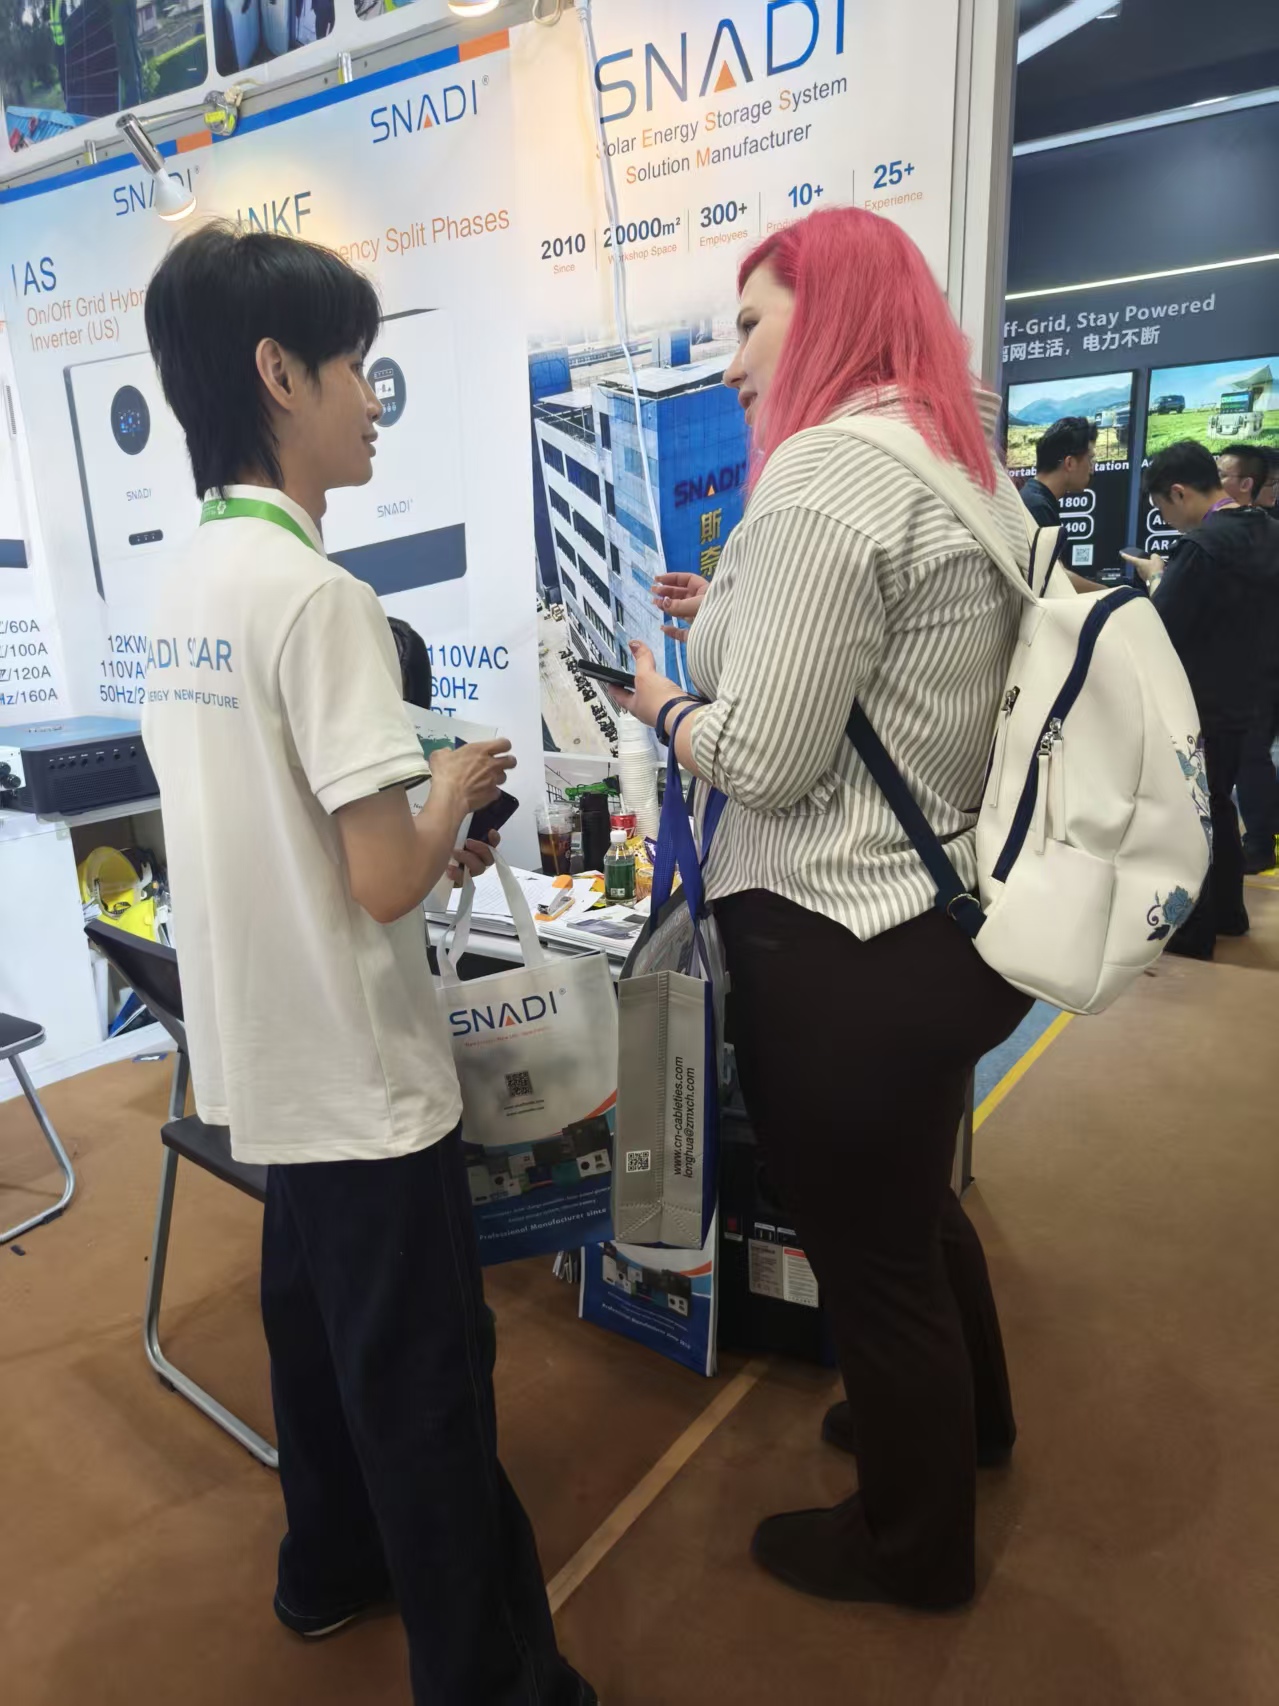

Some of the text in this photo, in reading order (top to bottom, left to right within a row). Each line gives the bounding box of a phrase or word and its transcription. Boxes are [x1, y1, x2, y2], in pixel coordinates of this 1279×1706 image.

[595, 0, 845, 124] SNADI
[371, 79, 477, 143] SNADI
[642, 120, 699, 149] Energy
[704, 99, 772, 132] Storage
[779, 77, 848, 112] System
[626, 124, 812, 184] Solution Manufacturer
[873, 160, 915, 189] 25+
[788, 183, 824, 208] 10+
[864, 190, 924, 212] Experience
[700, 201, 748, 228] 300+
[386, 222, 427, 256] Split
[432, 209, 510, 244] Phases
[541, 233, 586, 260] 2010
[699, 229, 748, 248] Employees
[553, 262, 575, 275] Since
[608, 242, 678, 267] Wrkshop Space
[27, 284, 147, 326] On/Off Grid Hybr
[1003, 293, 1216, 338] ff-Grid, Stay Powered
[30, 327, 83, 352] Inverter
[88, 316, 120, 345] (US)
[126, 488, 152, 501] SNADI
[377, 499, 410, 518] SNADI
[174, 688, 194, 701] NEW
[195, 691, 240, 709] FUTURE
[449, 991, 557, 1036] SNADI
[672, 1056, 683, 1175] www.cn-cableties.com
[683, 1067, 696, 1179] longhua@zmxch.com
